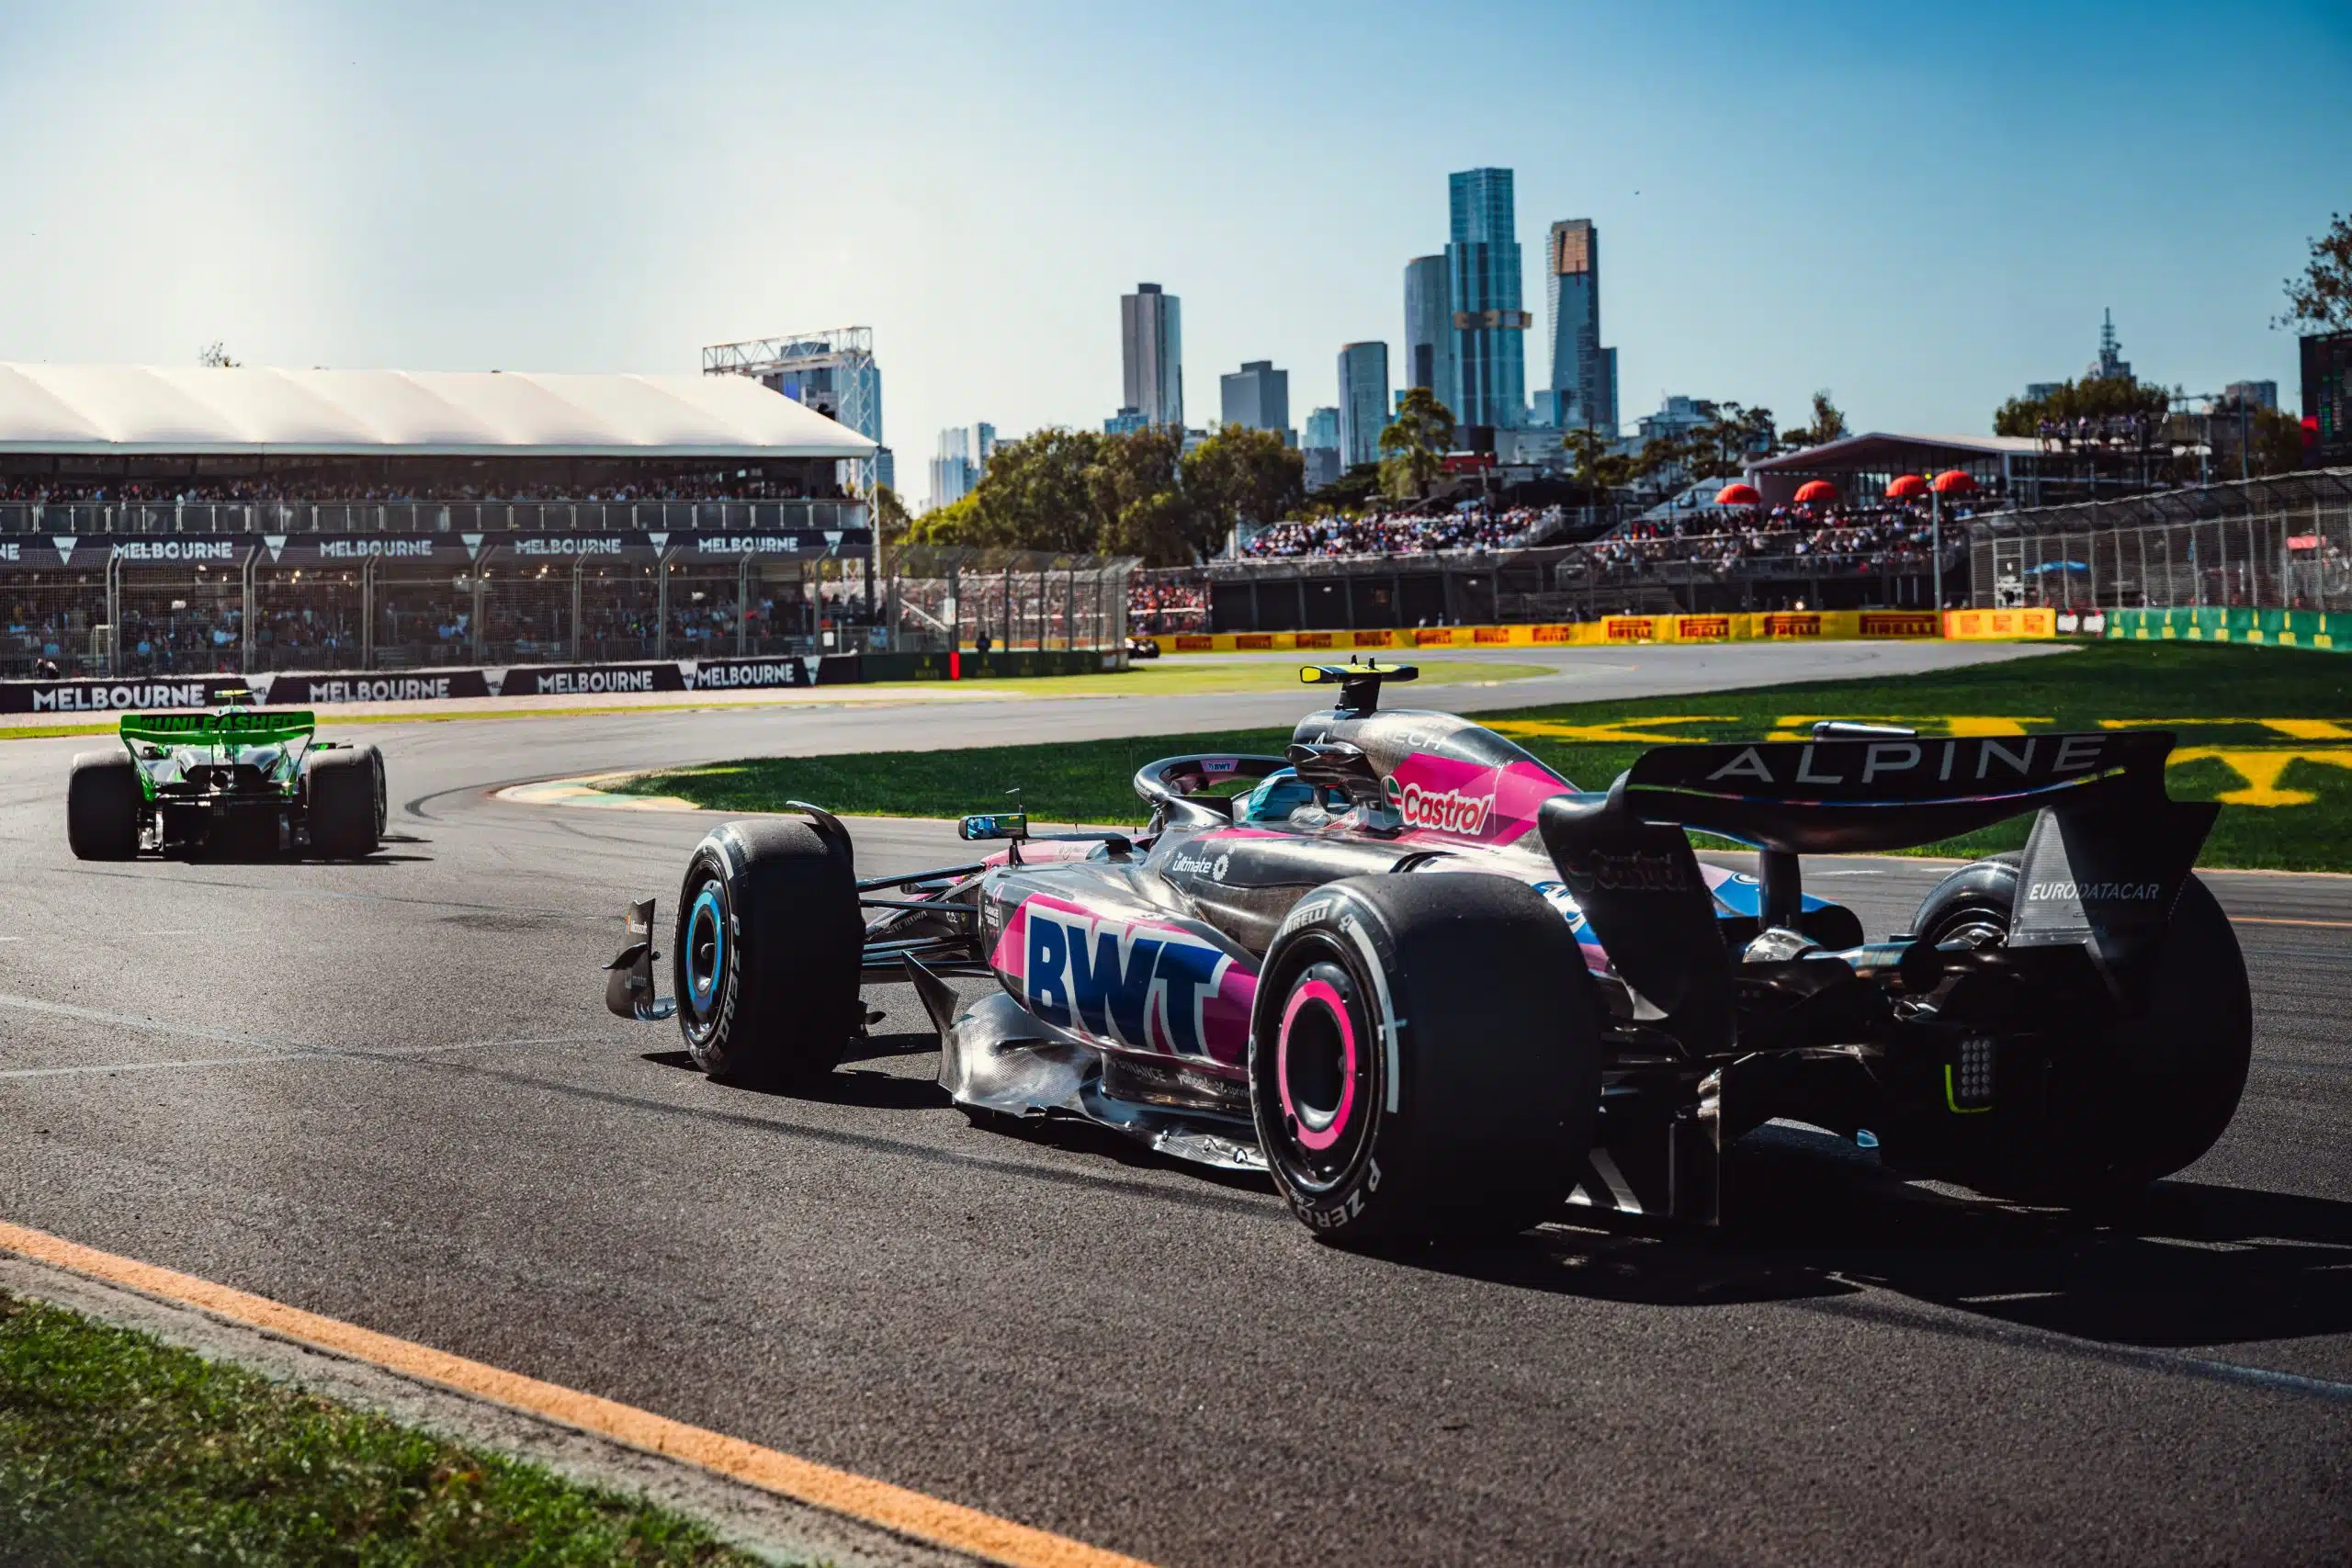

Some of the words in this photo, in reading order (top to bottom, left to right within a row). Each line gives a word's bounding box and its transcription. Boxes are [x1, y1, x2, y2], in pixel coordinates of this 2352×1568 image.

[112, 541, 233, 559] MELBOURNE
[319, 539, 433, 557] MELBOURNE
[514, 538, 622, 556] MELBOURNE
[698, 536, 799, 553] MELBOURNE
[537, 670, 654, 695] MELBOURNE
[696, 662, 796, 688] MELBOURNE
[32, 683, 206, 713] MELBOURNE
[309, 678, 451, 704] MELBOURNE
[1214, 762, 1231, 771] BWT
[1706, 735, 2109, 785] ALPINE
[1402, 783, 1495, 836] Castrol
[1171, 852, 1213, 874] ultimate
[2028, 882, 2160, 902] EURODATACAR
[1280, 898, 1331, 940] PIRELLI
[1026, 911, 1228, 1057] BWT
[1296, 1196, 1366, 1229] ZERO
